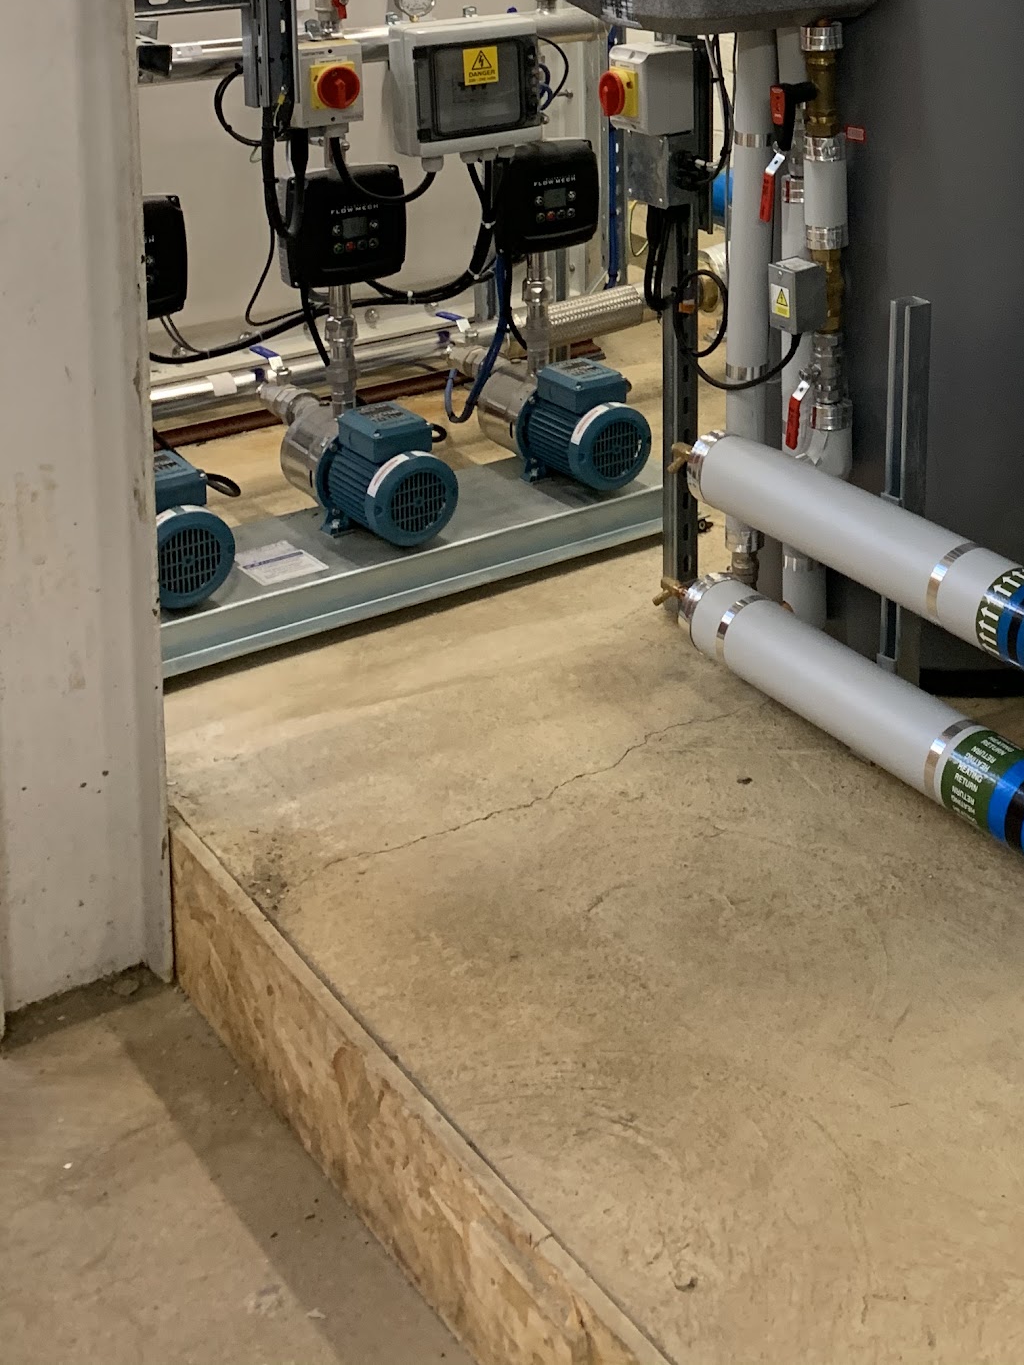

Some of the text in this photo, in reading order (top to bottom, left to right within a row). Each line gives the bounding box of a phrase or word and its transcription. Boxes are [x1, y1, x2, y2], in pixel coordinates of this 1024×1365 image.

[469, 70, 496, 78] DANGER
[954, 772, 978, 793] RETURN
[957, 762, 983, 784] HEATING
[951, 785, 975, 806] RETURN
